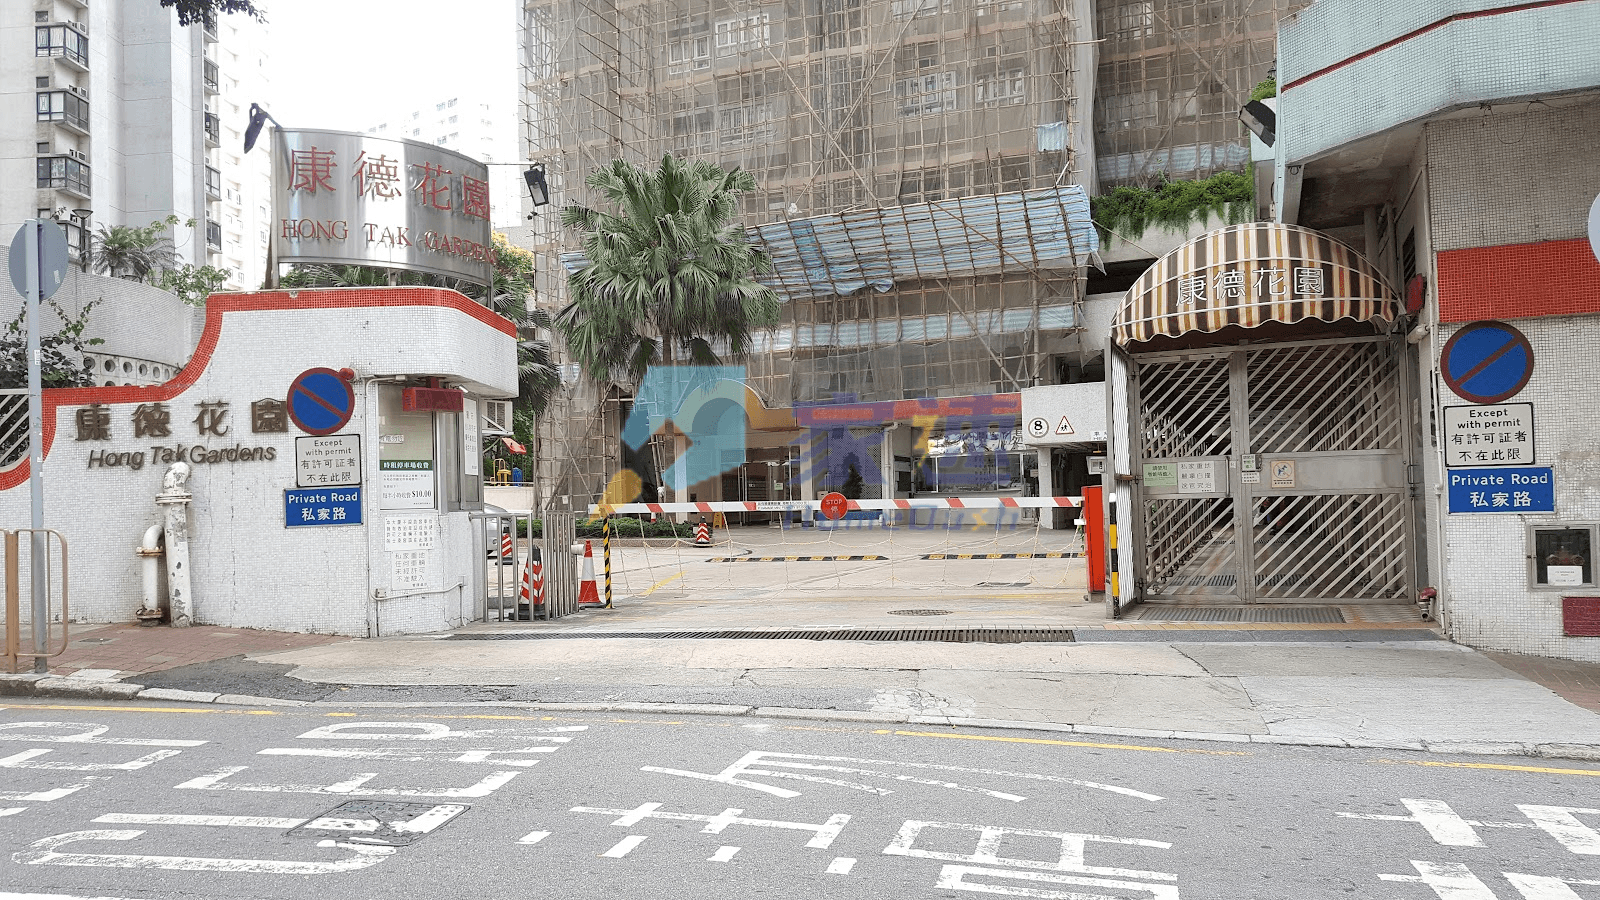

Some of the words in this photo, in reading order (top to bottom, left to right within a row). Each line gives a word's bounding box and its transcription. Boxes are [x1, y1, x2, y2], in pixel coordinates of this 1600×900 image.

[287, 146, 491, 221] 康德花園
[281, 219, 348, 241] HONG
[363, 222, 412, 247] TAK
[424, 230, 498, 265] GARDENS
[1175, 266, 1325, 307] 康德花園
[75, 398, 289, 441] 康德花園
[1469, 408, 1508, 418] Except
[1034, 420, 1043, 431] 8
[1457, 420, 1481, 429] with
[1484, 418, 1521, 429] permit
[314, 439, 343, 447] Except
[1451, 430, 1527, 445] 有許可証者
[88, 449, 145, 470] Hong
[150, 444, 190, 465] Tak
[190, 444, 277, 465] Gardens
[305, 448, 323, 456] with
[325, 447, 352, 456] permit
[1459, 448, 1521, 462] 不在此限
[301, 457, 356, 469] 有許可証者
[306, 471, 352, 483] 不在此限
[1451, 474, 1505, 486] Private
[1510, 472, 1548, 485] Road
[288, 493, 327, 504] Private
[331, 491, 358, 502] Road
[411, 490, 432, 498] $10.00
[1469, 490, 1532, 508] 私家路
[301, 506, 346, 521] 私家路
[830, 505, 839, 514] 停
[12, 721, 588, 875] CLEAR
